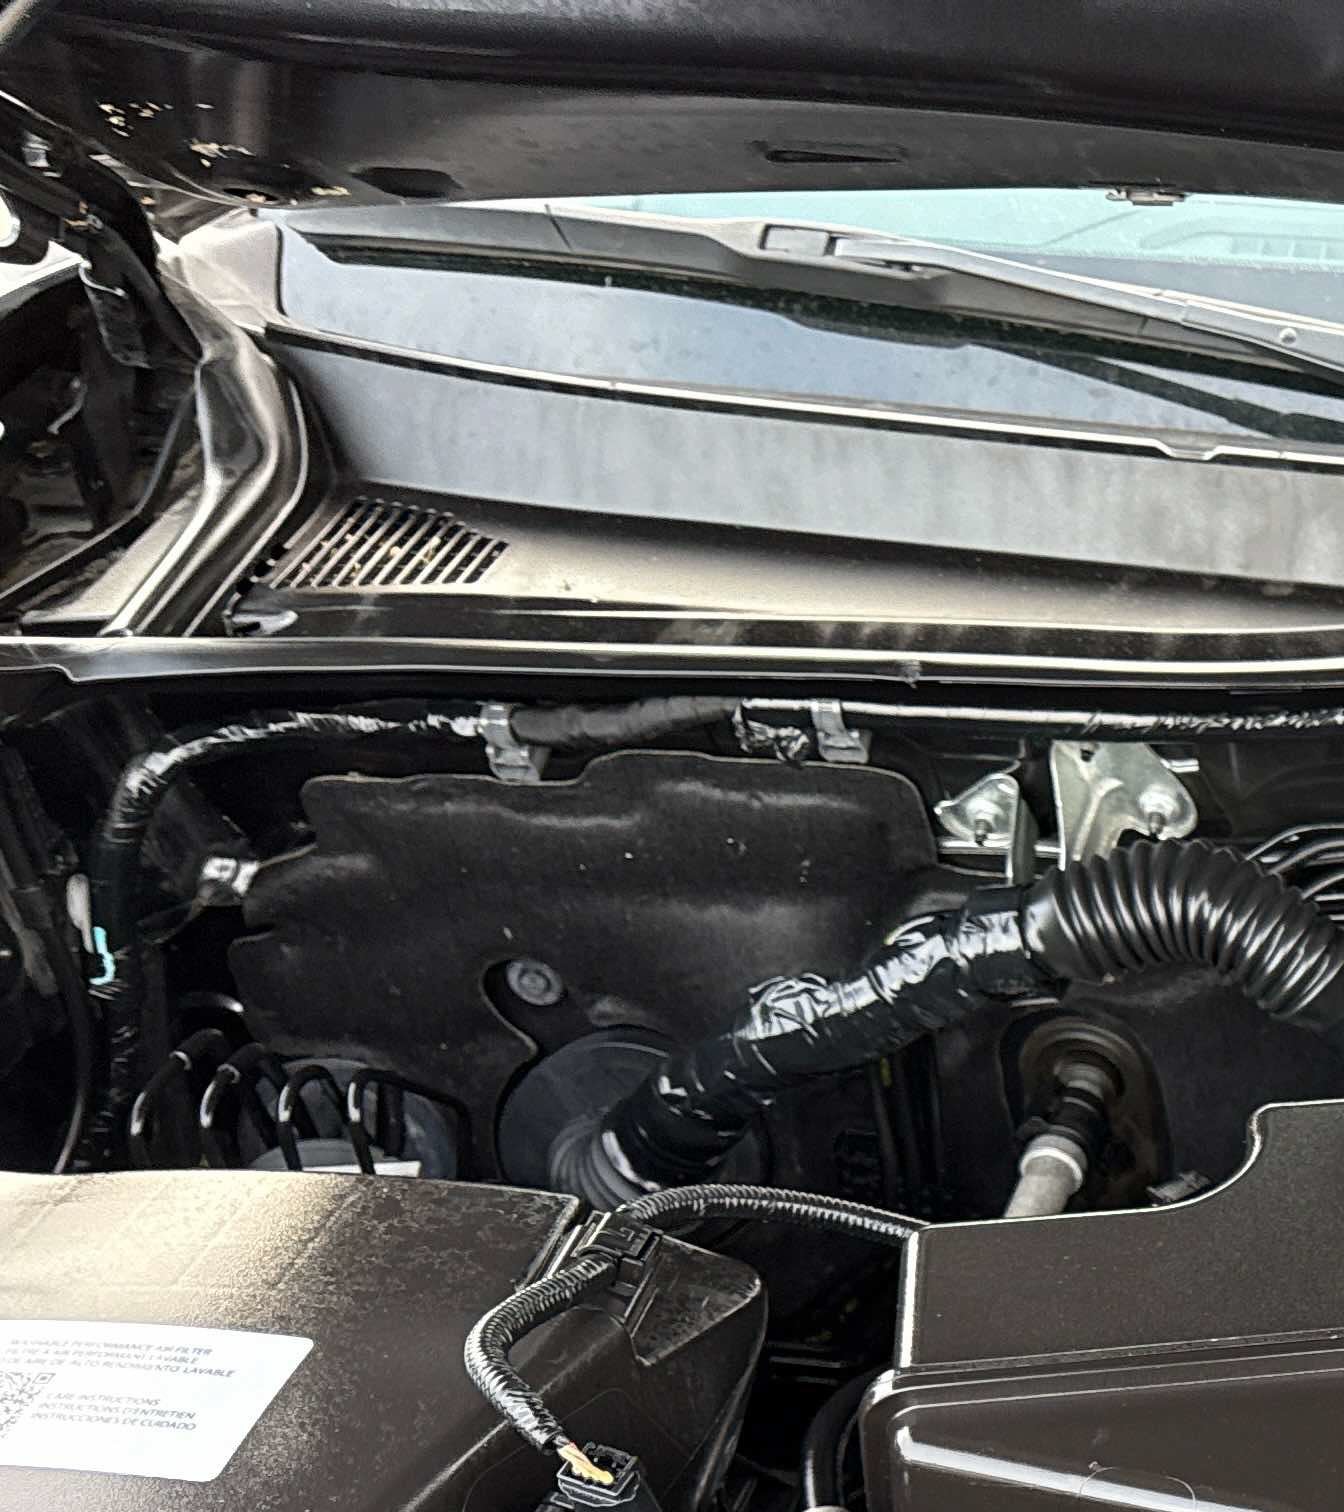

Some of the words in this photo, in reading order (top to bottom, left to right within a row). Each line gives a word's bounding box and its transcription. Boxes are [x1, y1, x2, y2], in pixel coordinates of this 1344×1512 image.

[175, 1347, 213, 1356] FILTER
[182, 1367, 237, 1378] LAVABLE
[141, 1418, 197, 1431] CUIDADO
